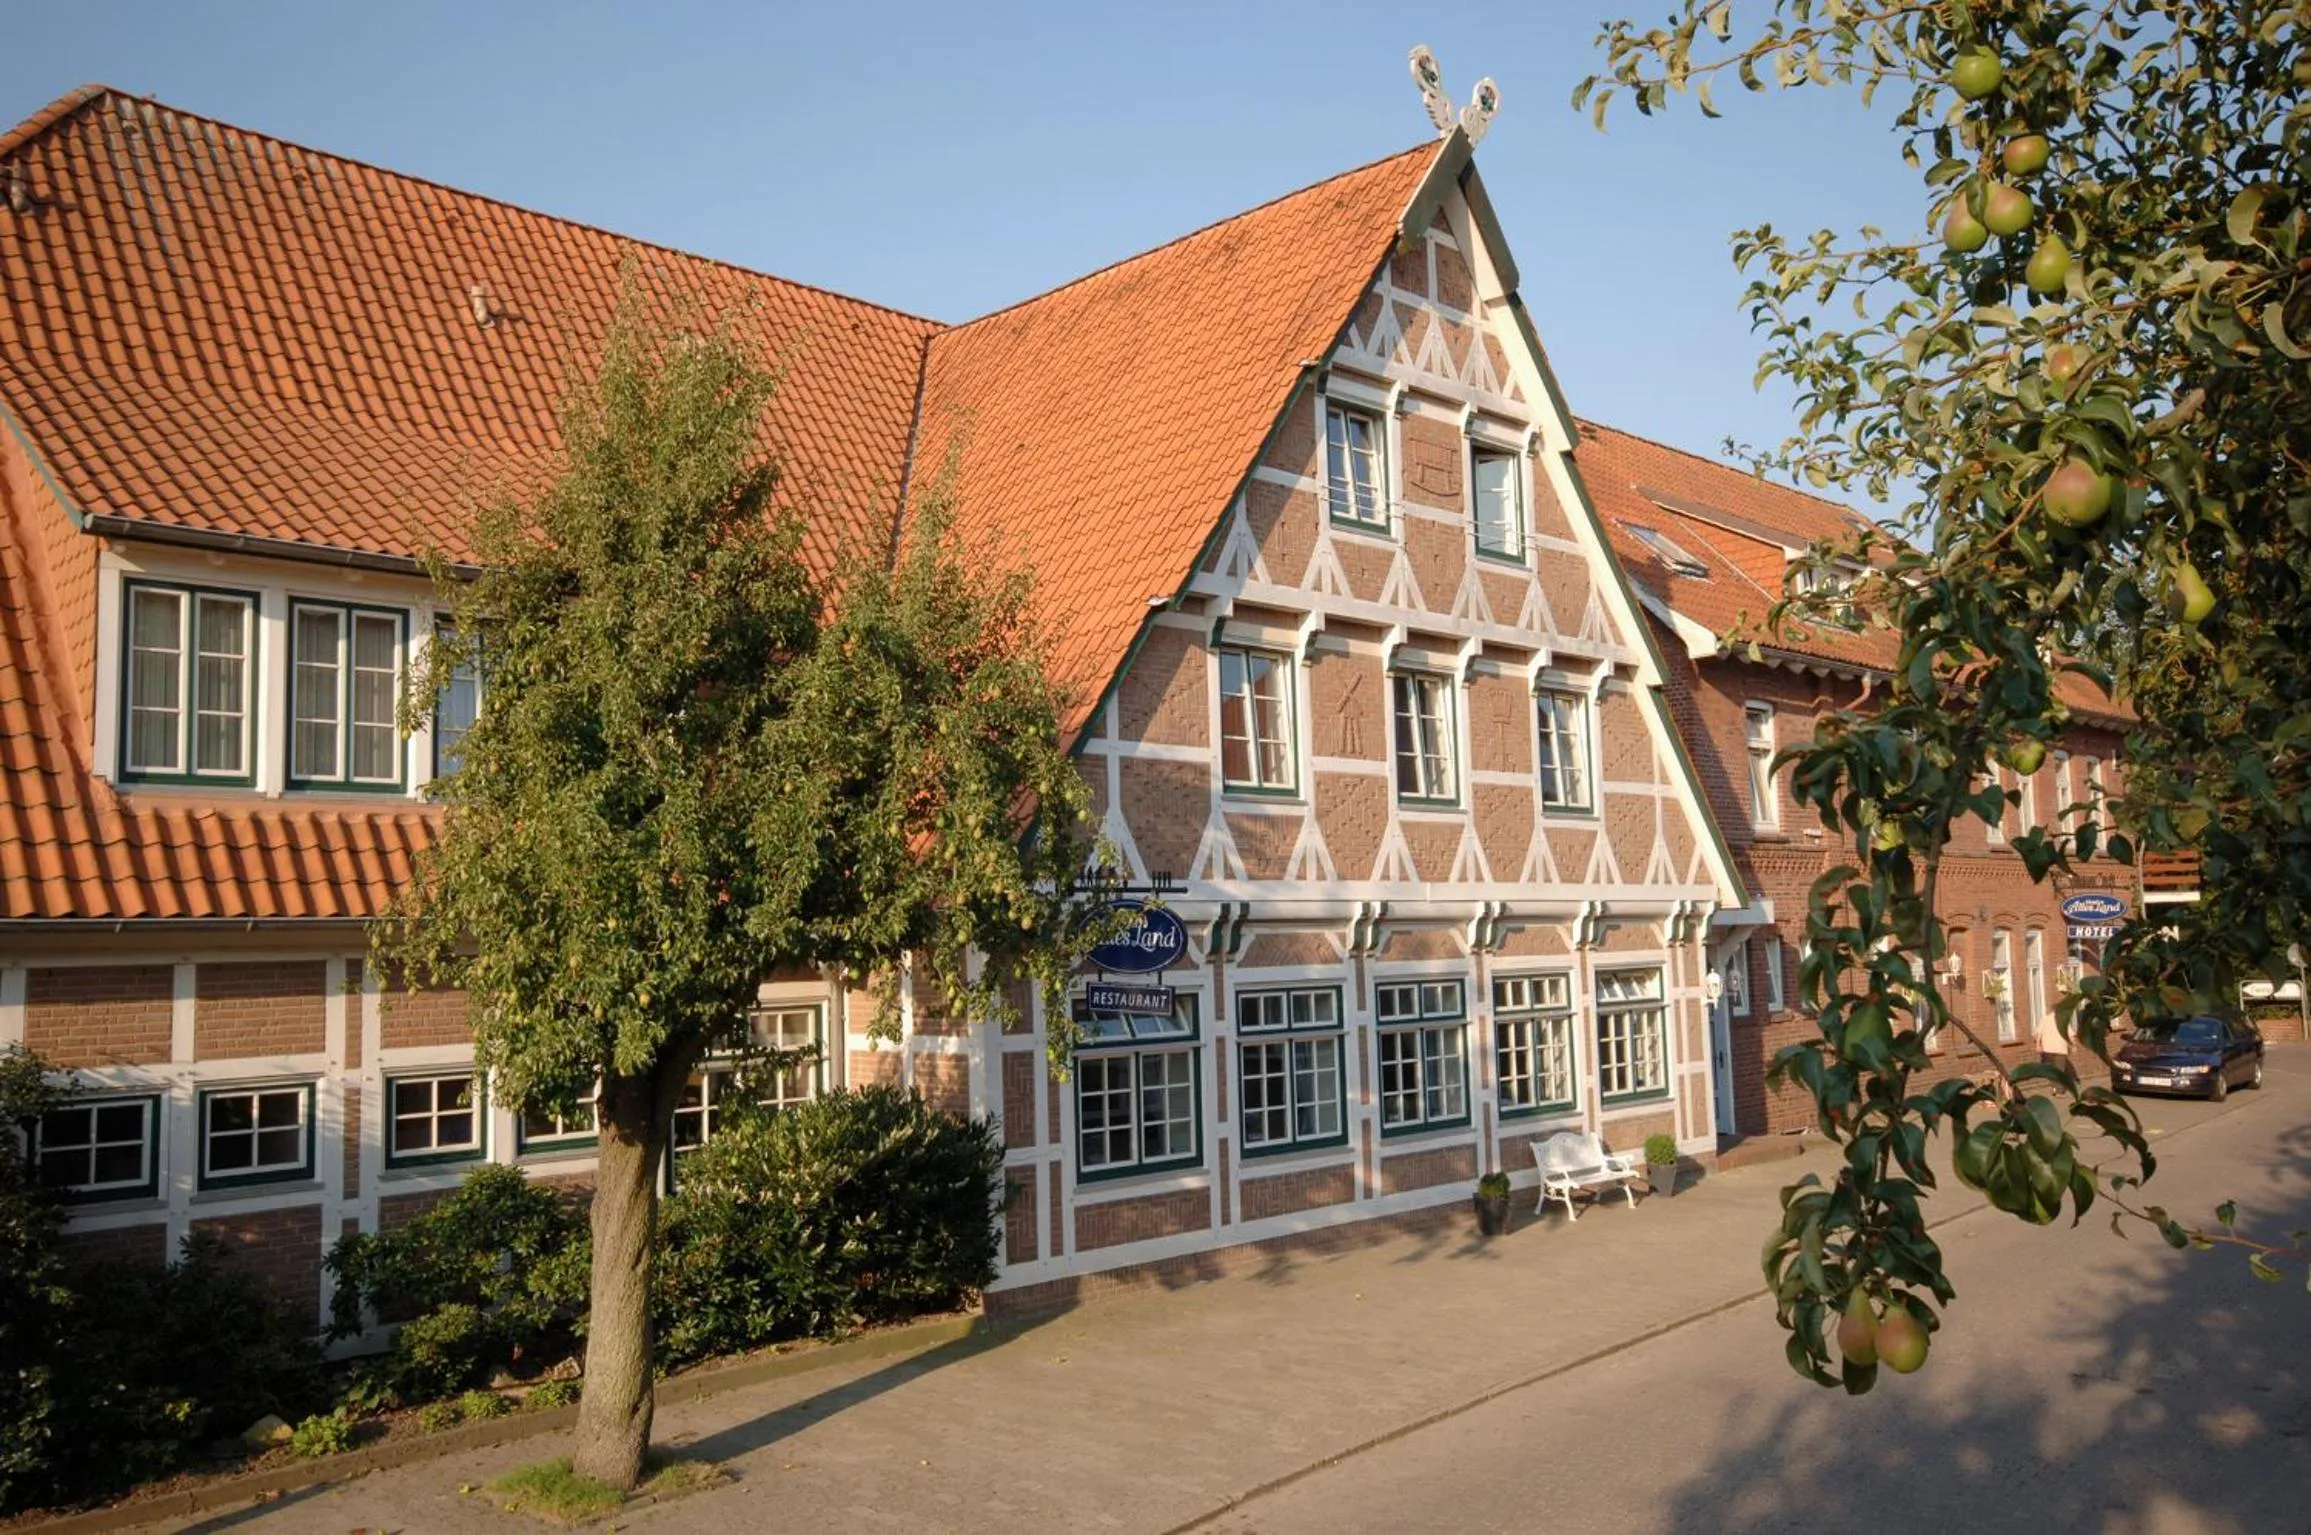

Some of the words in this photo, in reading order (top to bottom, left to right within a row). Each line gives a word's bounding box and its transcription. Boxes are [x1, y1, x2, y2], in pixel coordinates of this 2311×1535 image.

[1132, 925, 1176, 952] Land
[2076, 927, 2114, 938] HOTEL
[1093, 991, 1168, 1009] RESTAURANT
